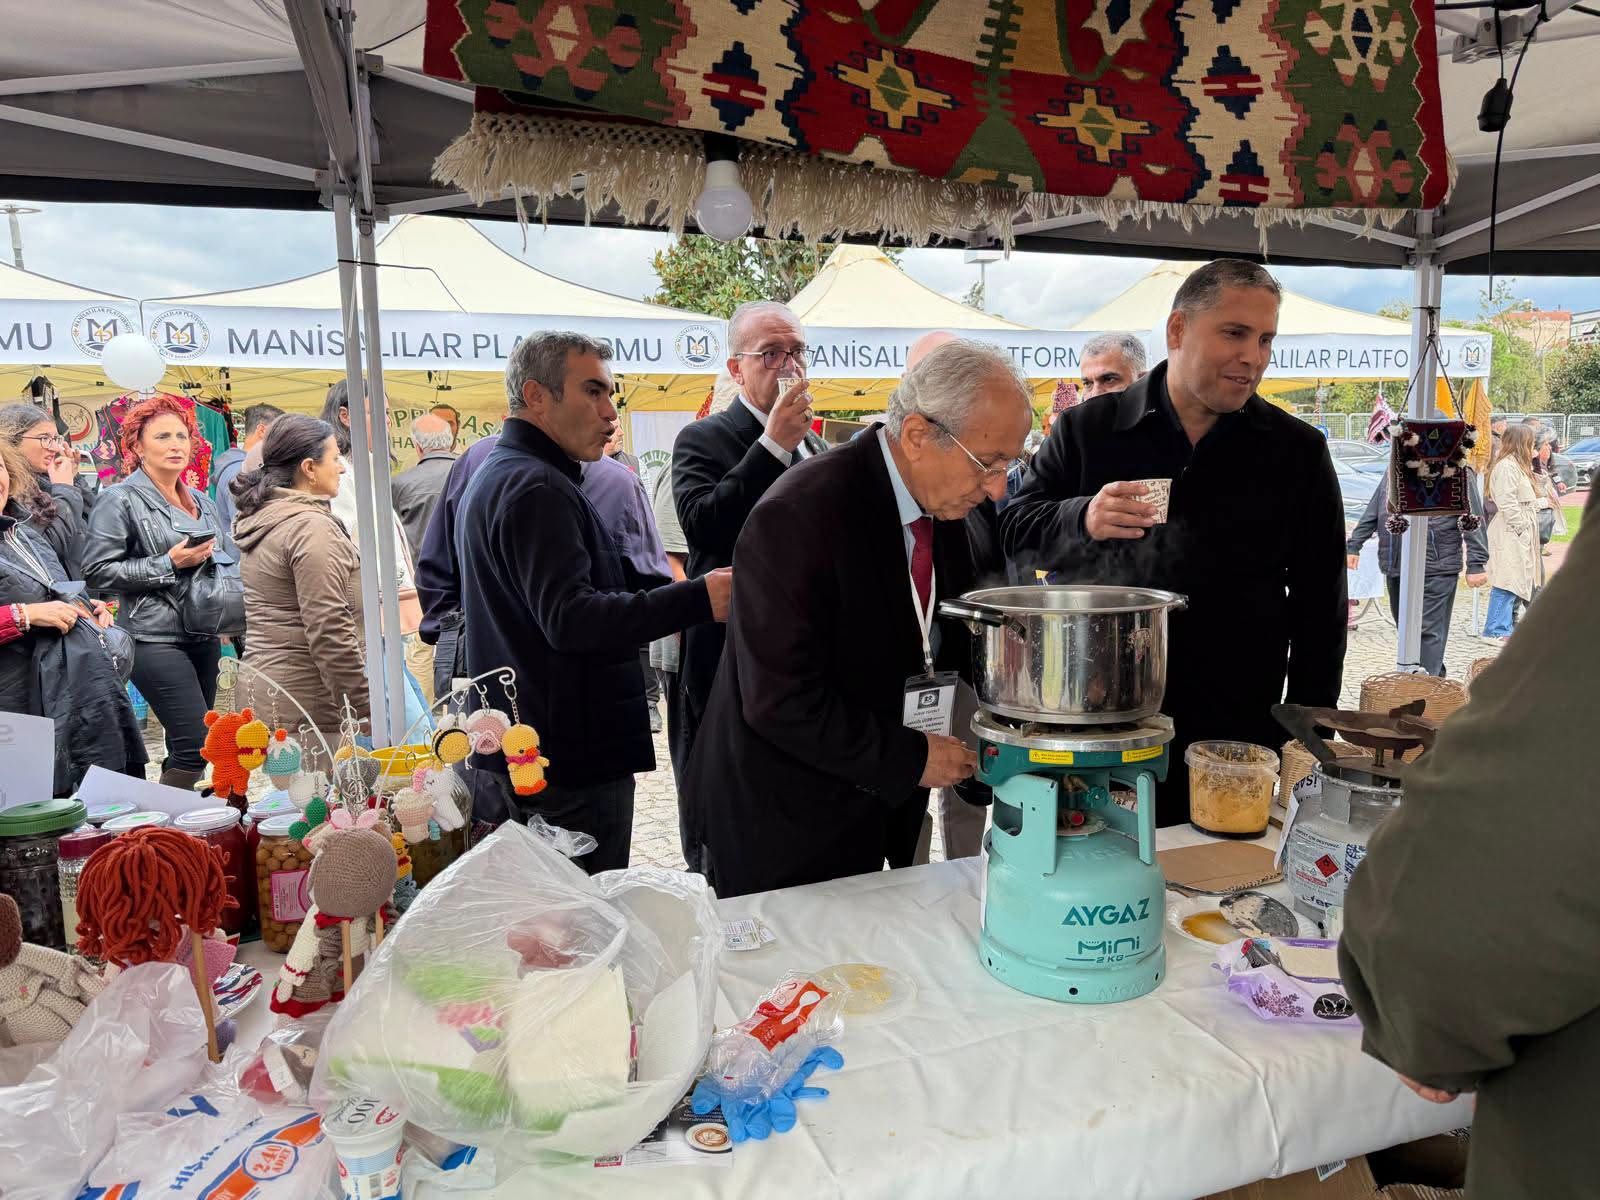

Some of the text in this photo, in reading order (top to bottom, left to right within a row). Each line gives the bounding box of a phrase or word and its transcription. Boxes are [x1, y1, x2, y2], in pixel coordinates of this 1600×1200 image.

[227, 324, 463, 358] MANİSILAR
[1269, 348, 1451, 369] ALILAR PLATFOU
[1062, 897, 1150, 926] AYGAZ
[1095, 954, 1124, 964] 2 KG
